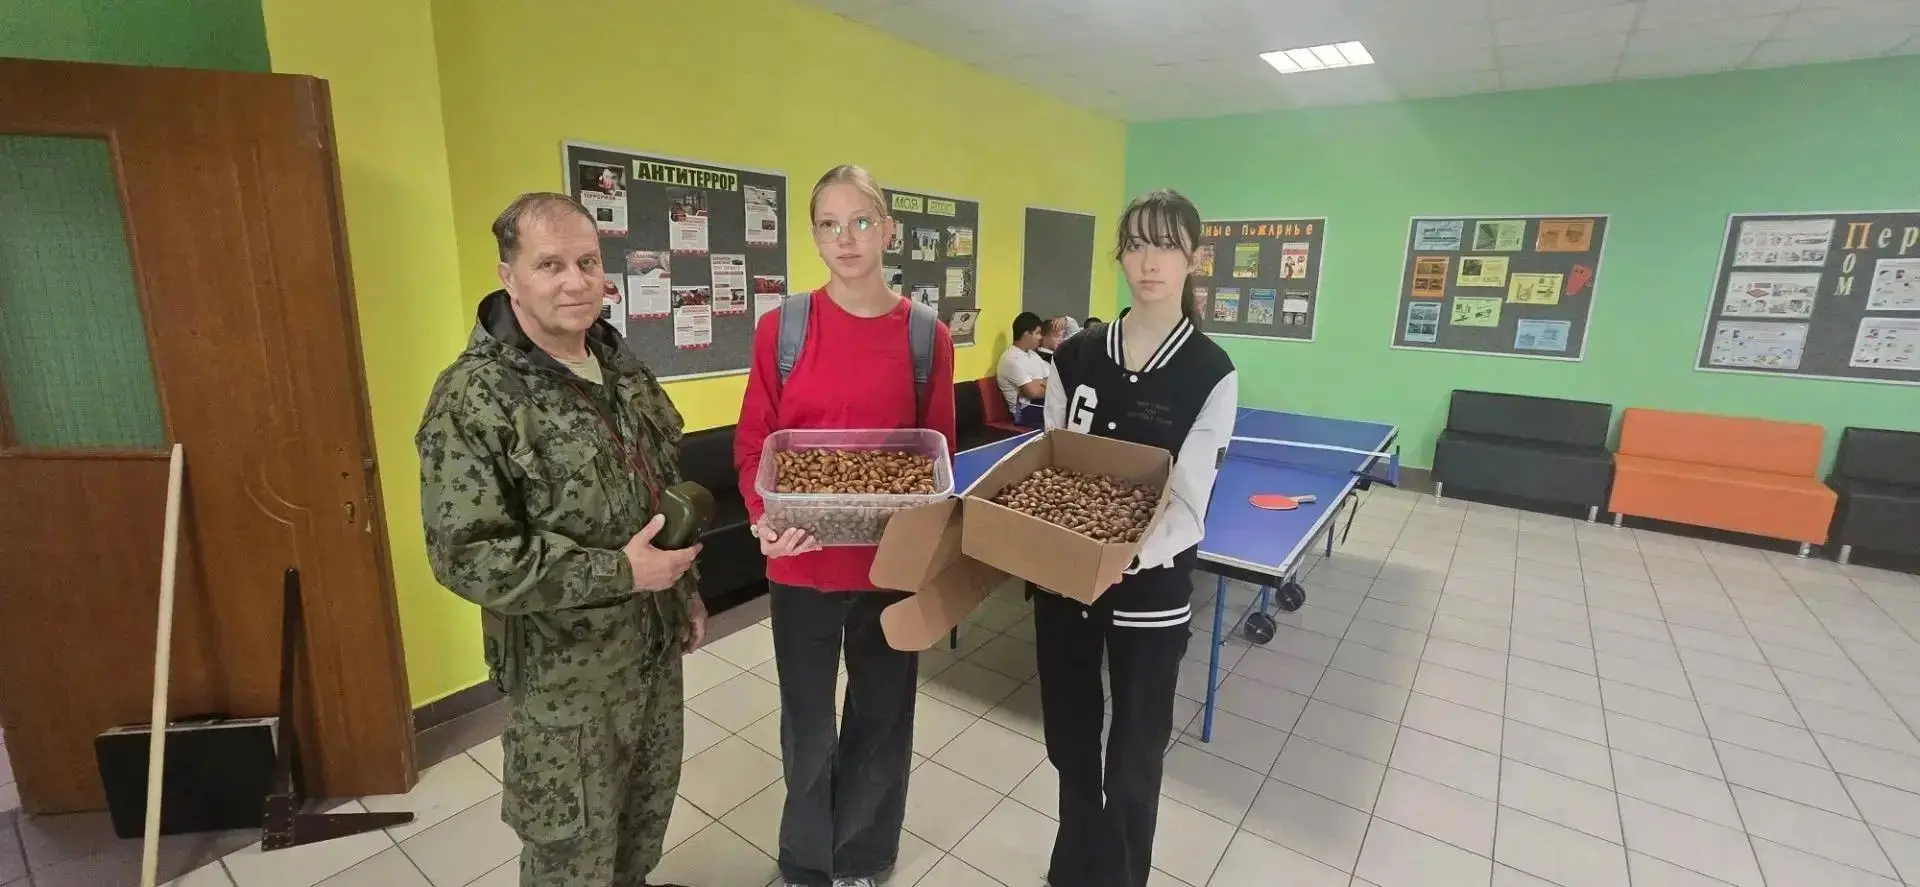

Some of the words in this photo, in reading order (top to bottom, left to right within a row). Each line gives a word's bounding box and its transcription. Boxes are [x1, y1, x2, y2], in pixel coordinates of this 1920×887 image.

[638, 162, 735, 190] АНТИТЕРРОР
[895, 197, 918, 210] МОЯ
[1067, 384, 1098, 434] G
